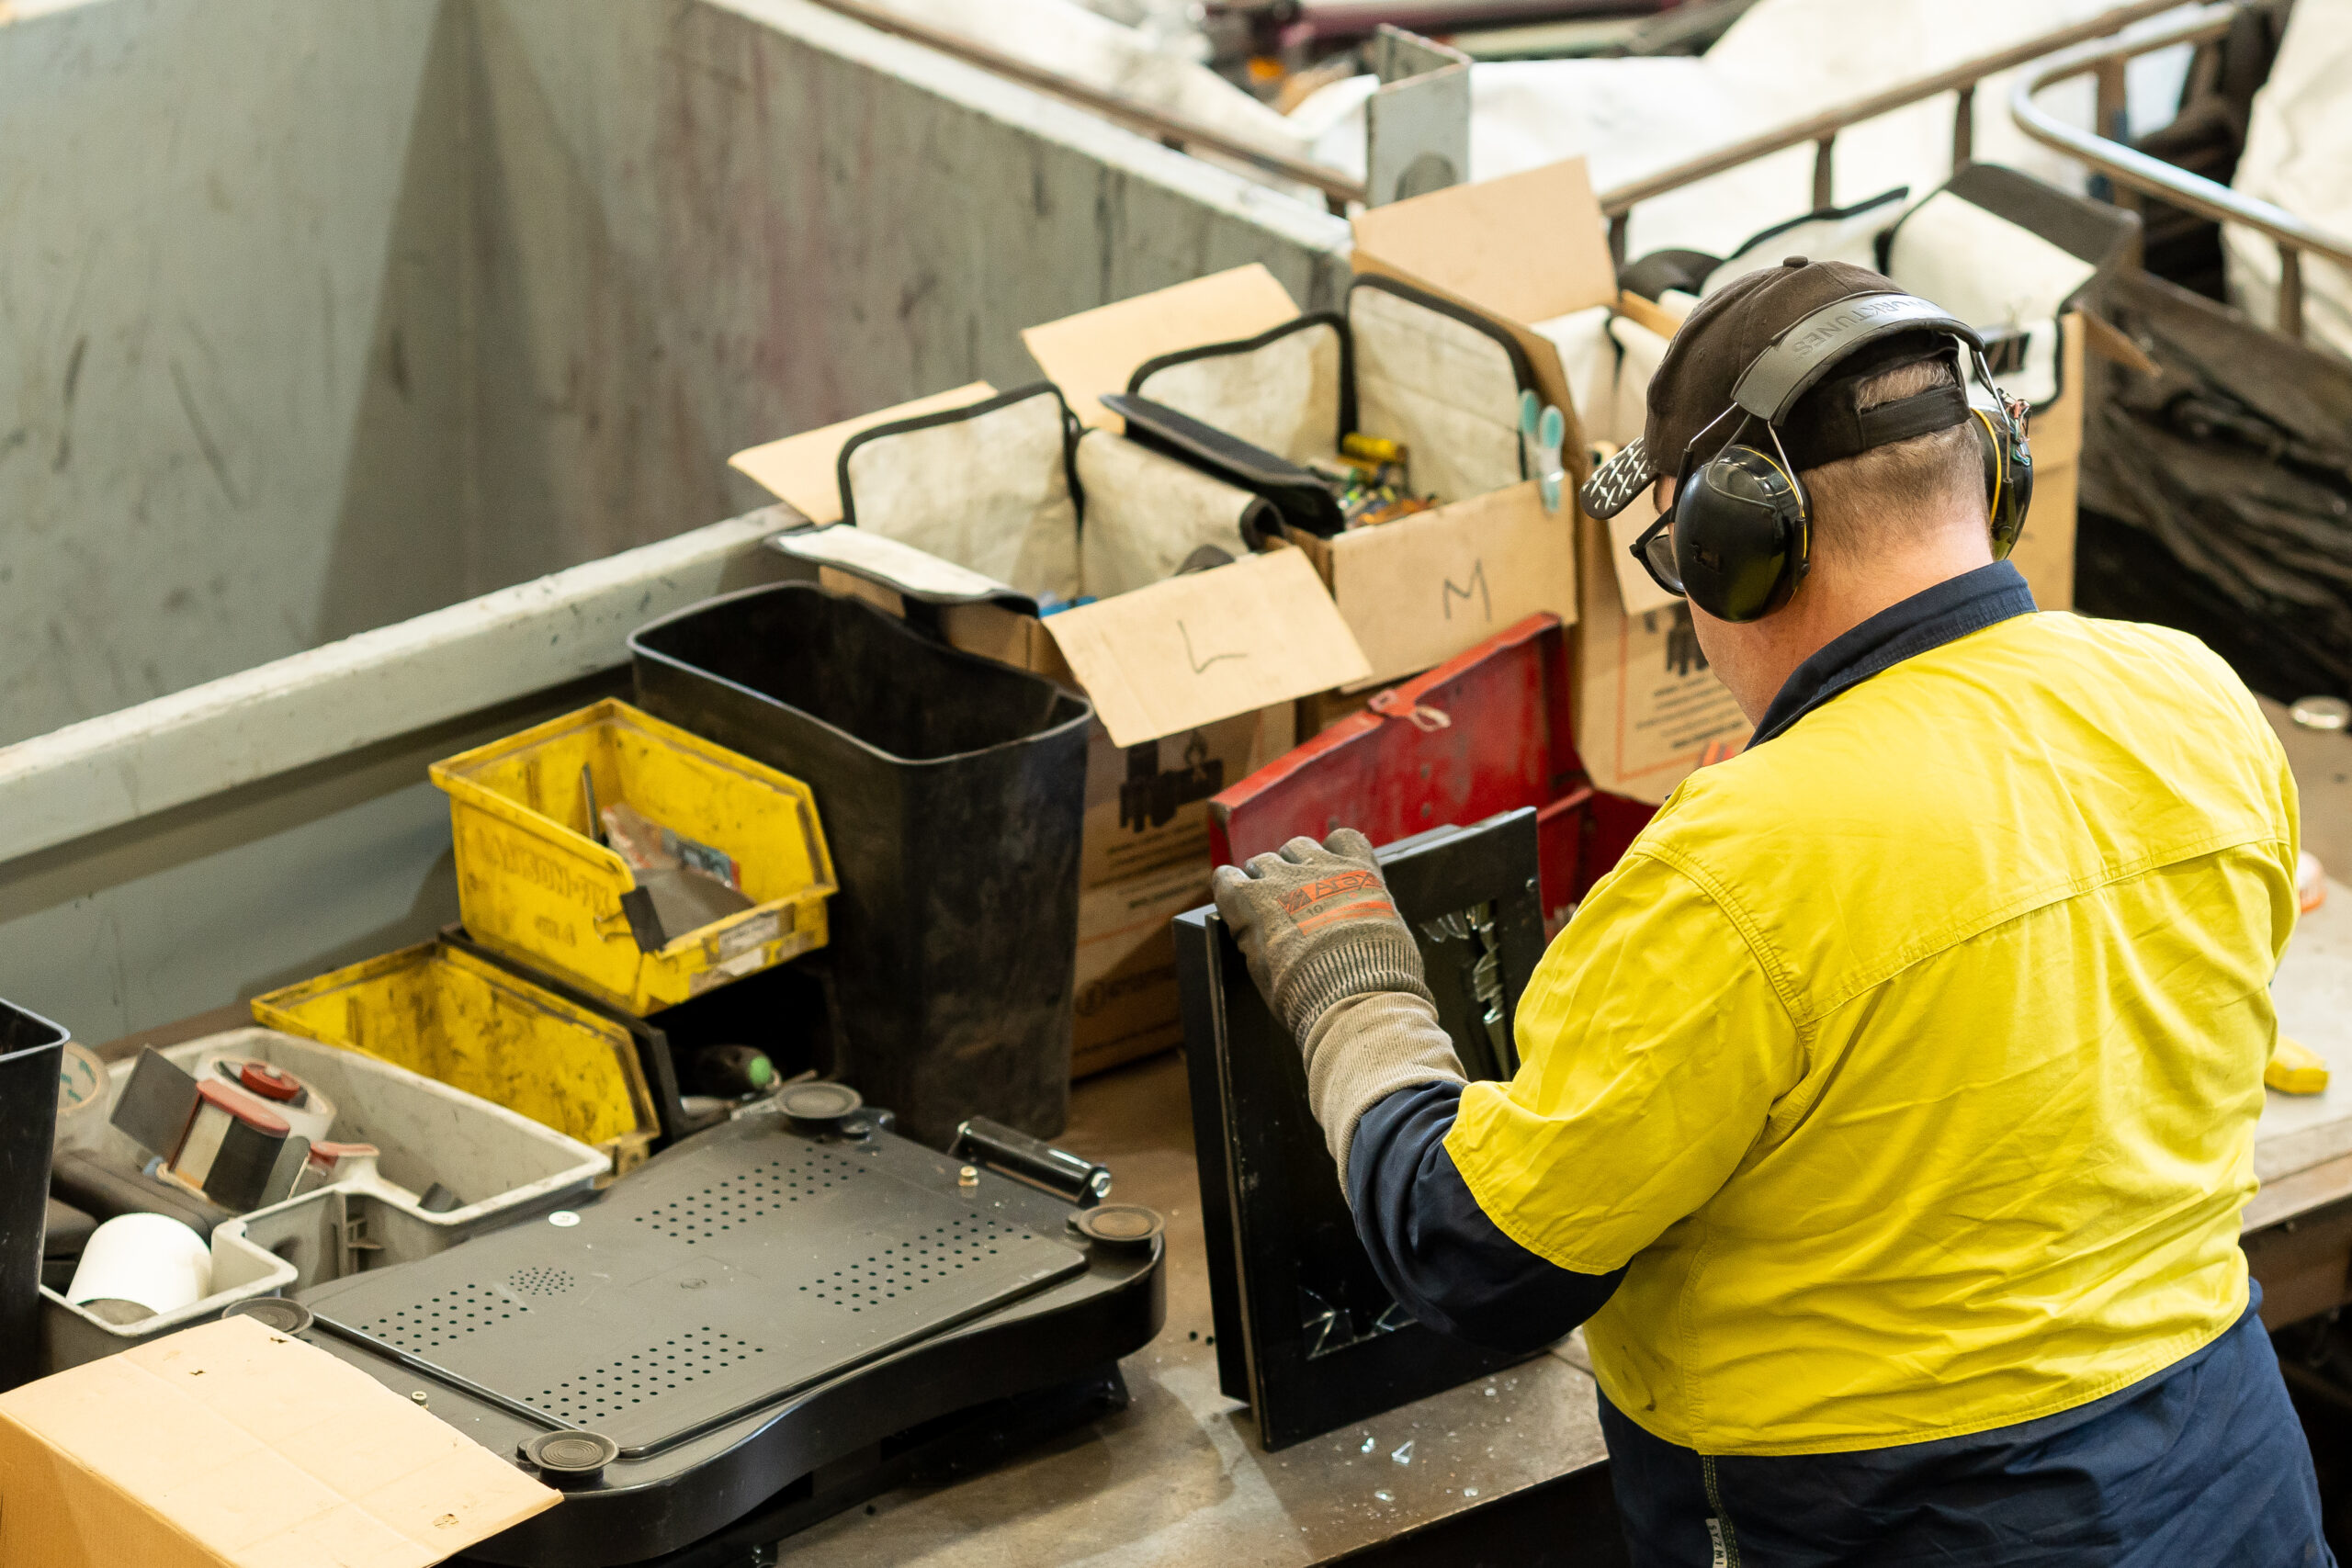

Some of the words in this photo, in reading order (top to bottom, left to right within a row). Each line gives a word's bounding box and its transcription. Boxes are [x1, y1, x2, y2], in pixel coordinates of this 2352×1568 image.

[1793, 300, 1933, 355] ORKTUNES
[1442, 558, 1491, 622] M
[1177, 620, 1248, 674] L
